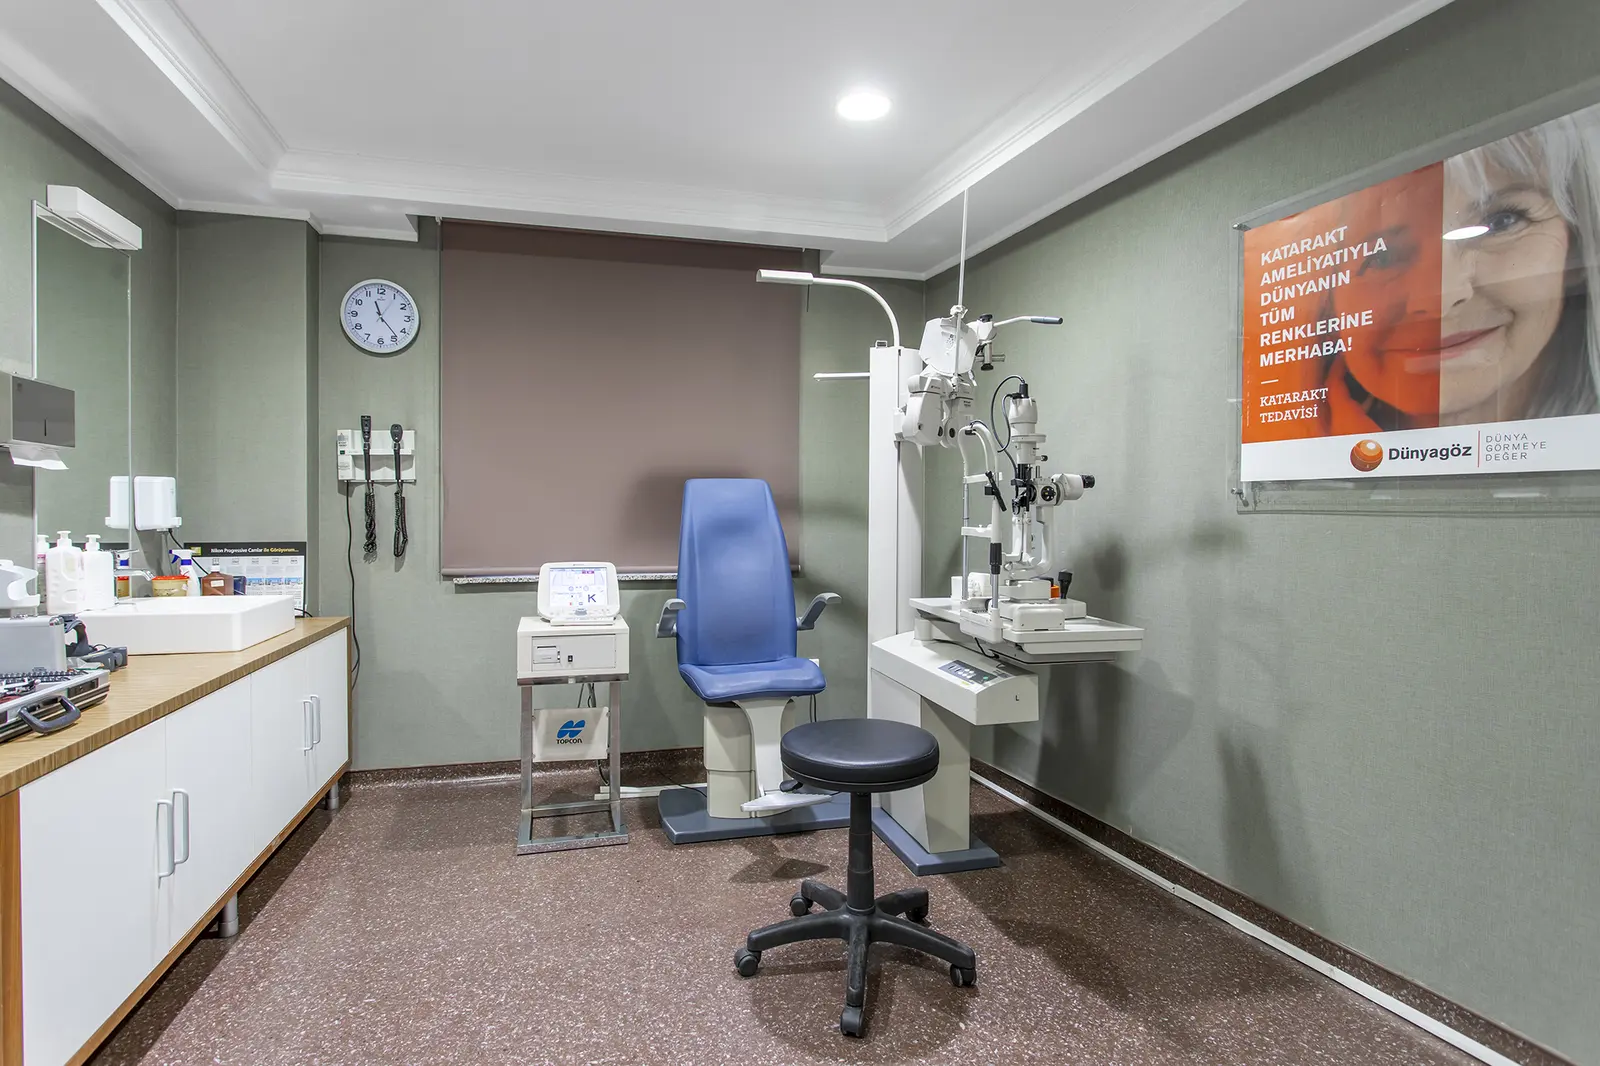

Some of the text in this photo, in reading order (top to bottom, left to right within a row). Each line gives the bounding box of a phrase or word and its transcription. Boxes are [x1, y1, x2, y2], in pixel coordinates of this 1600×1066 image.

[1261, 226, 1348, 266] KATARAKT
[1260, 237, 1388, 286] AMELİYATIYLA
[1260, 270, 1350, 306] DÜNYANIN
[1260, 306, 1295, 326] TÜM
[1260, 310, 1374, 347] RENKLERİNE
[1260, 337, 1352, 367] MERHABA!
[1260, 388, 1328, 407] KATARAKT
[1260, 404, 1318, 423] TEDAVİSİ
[1486, 433, 1528, 443] DÜNYA
[1486, 441, 1547, 452] GÖRMEYE
[1388, 443, 1472, 461] Dünyagöz
[1486, 452, 1528, 461] DEĞER
[588, 594, 596, 603] K
